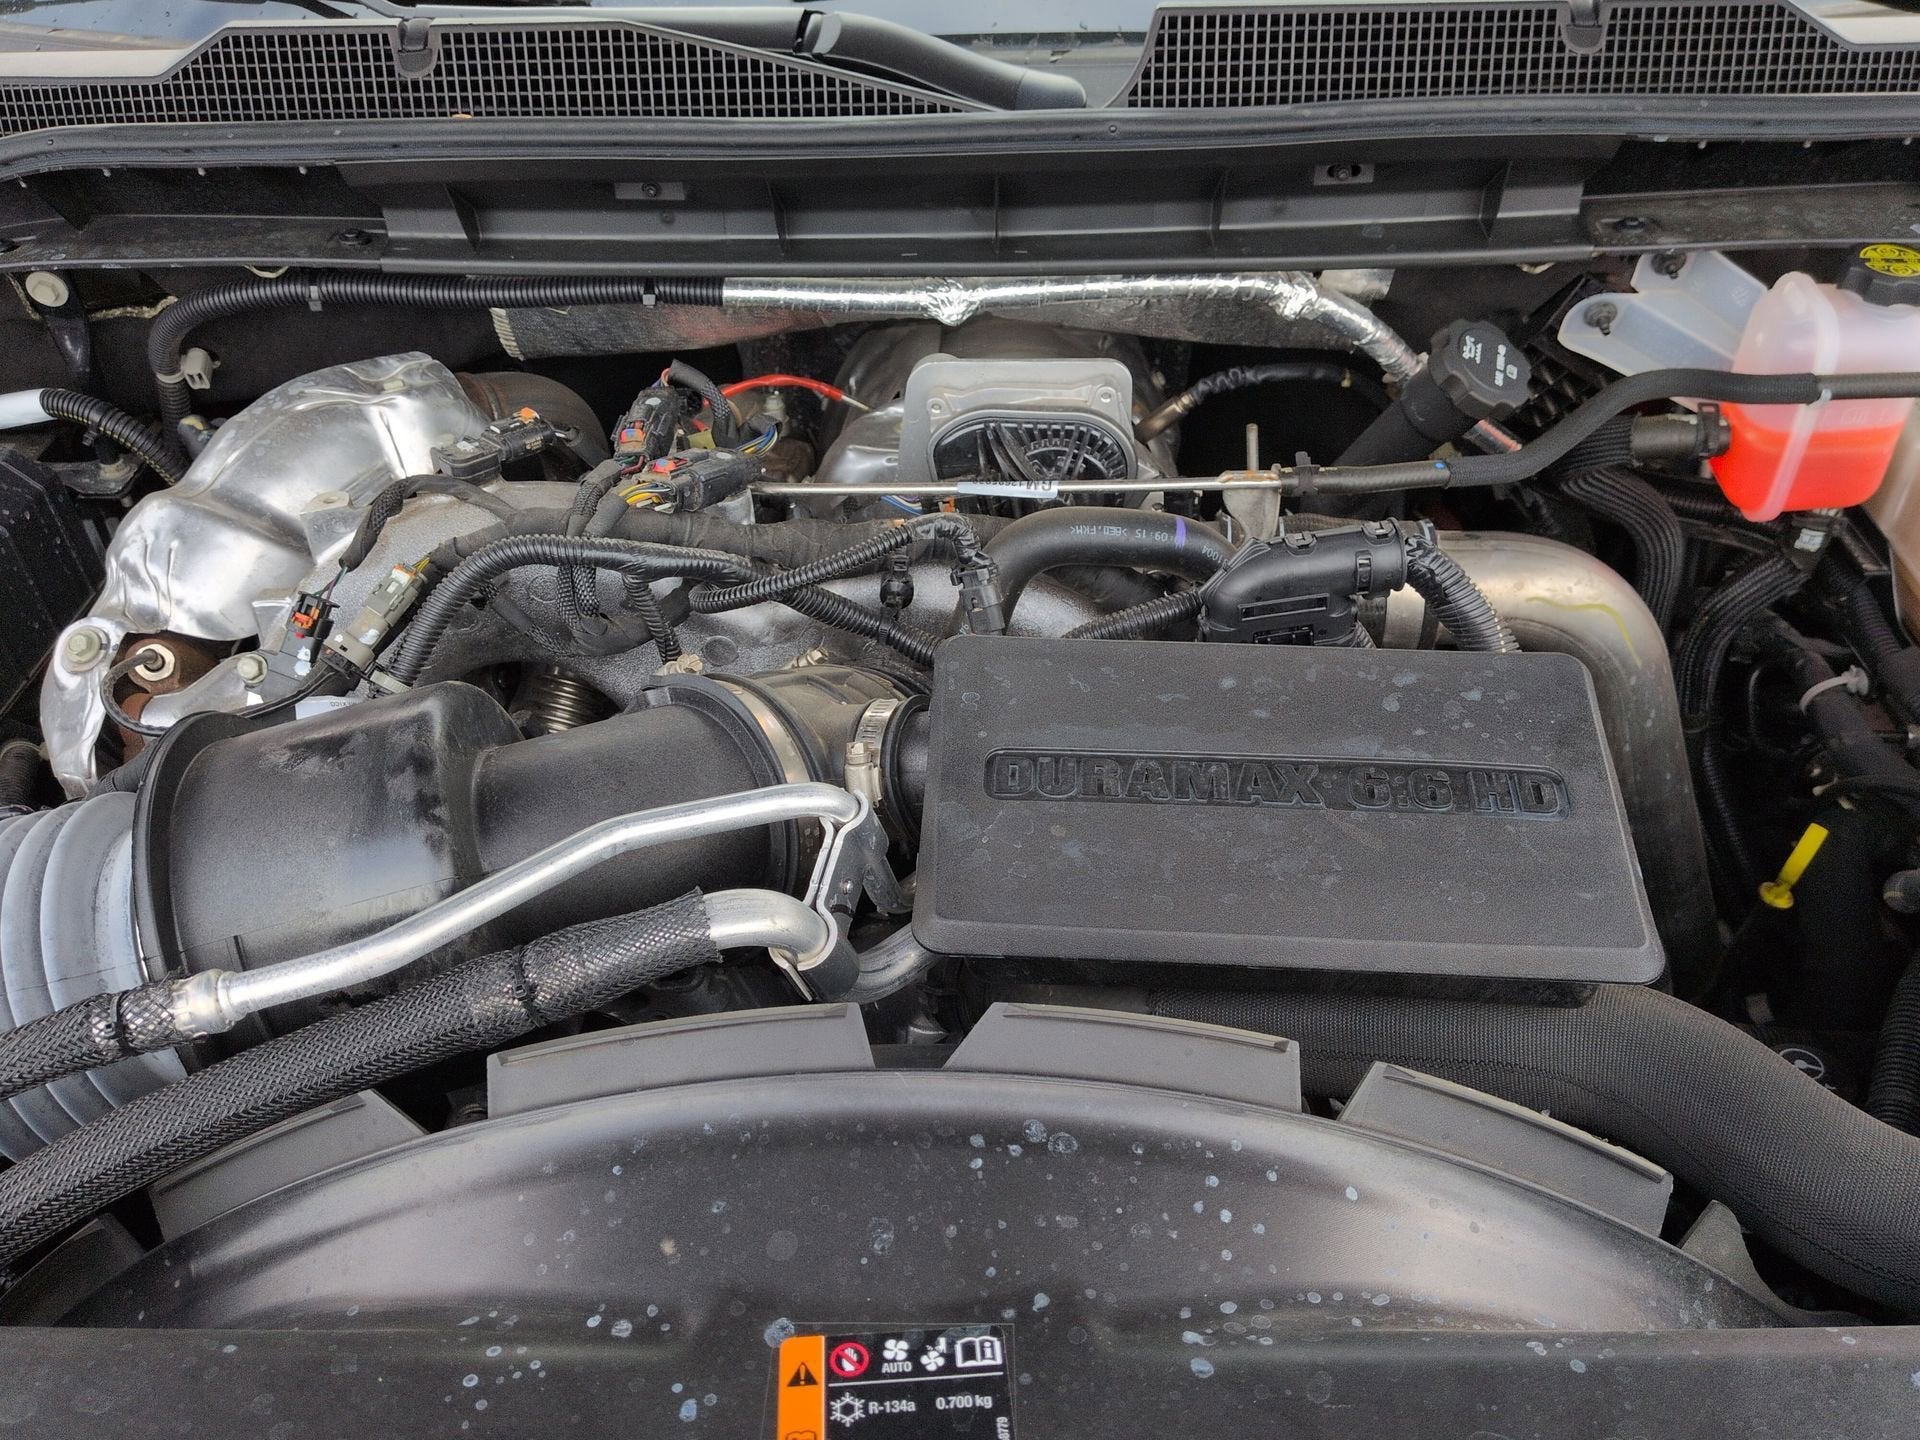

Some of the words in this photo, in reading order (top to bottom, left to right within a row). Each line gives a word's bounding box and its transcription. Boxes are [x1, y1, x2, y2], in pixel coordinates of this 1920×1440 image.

[992, 756, 1326, 806] DURAMAX
[1346, 766, 1456, 811] 6.6
[1466, 769, 1565, 817] HD
[881, 1361, 912, 1374] AUTO
[868, 1400, 917, 1415] R-134a
[935, 1396, 973, 1410] 0.700
[975, 1395, 993, 1409] kg
[996, 1416, 1009, 1440] 8779
